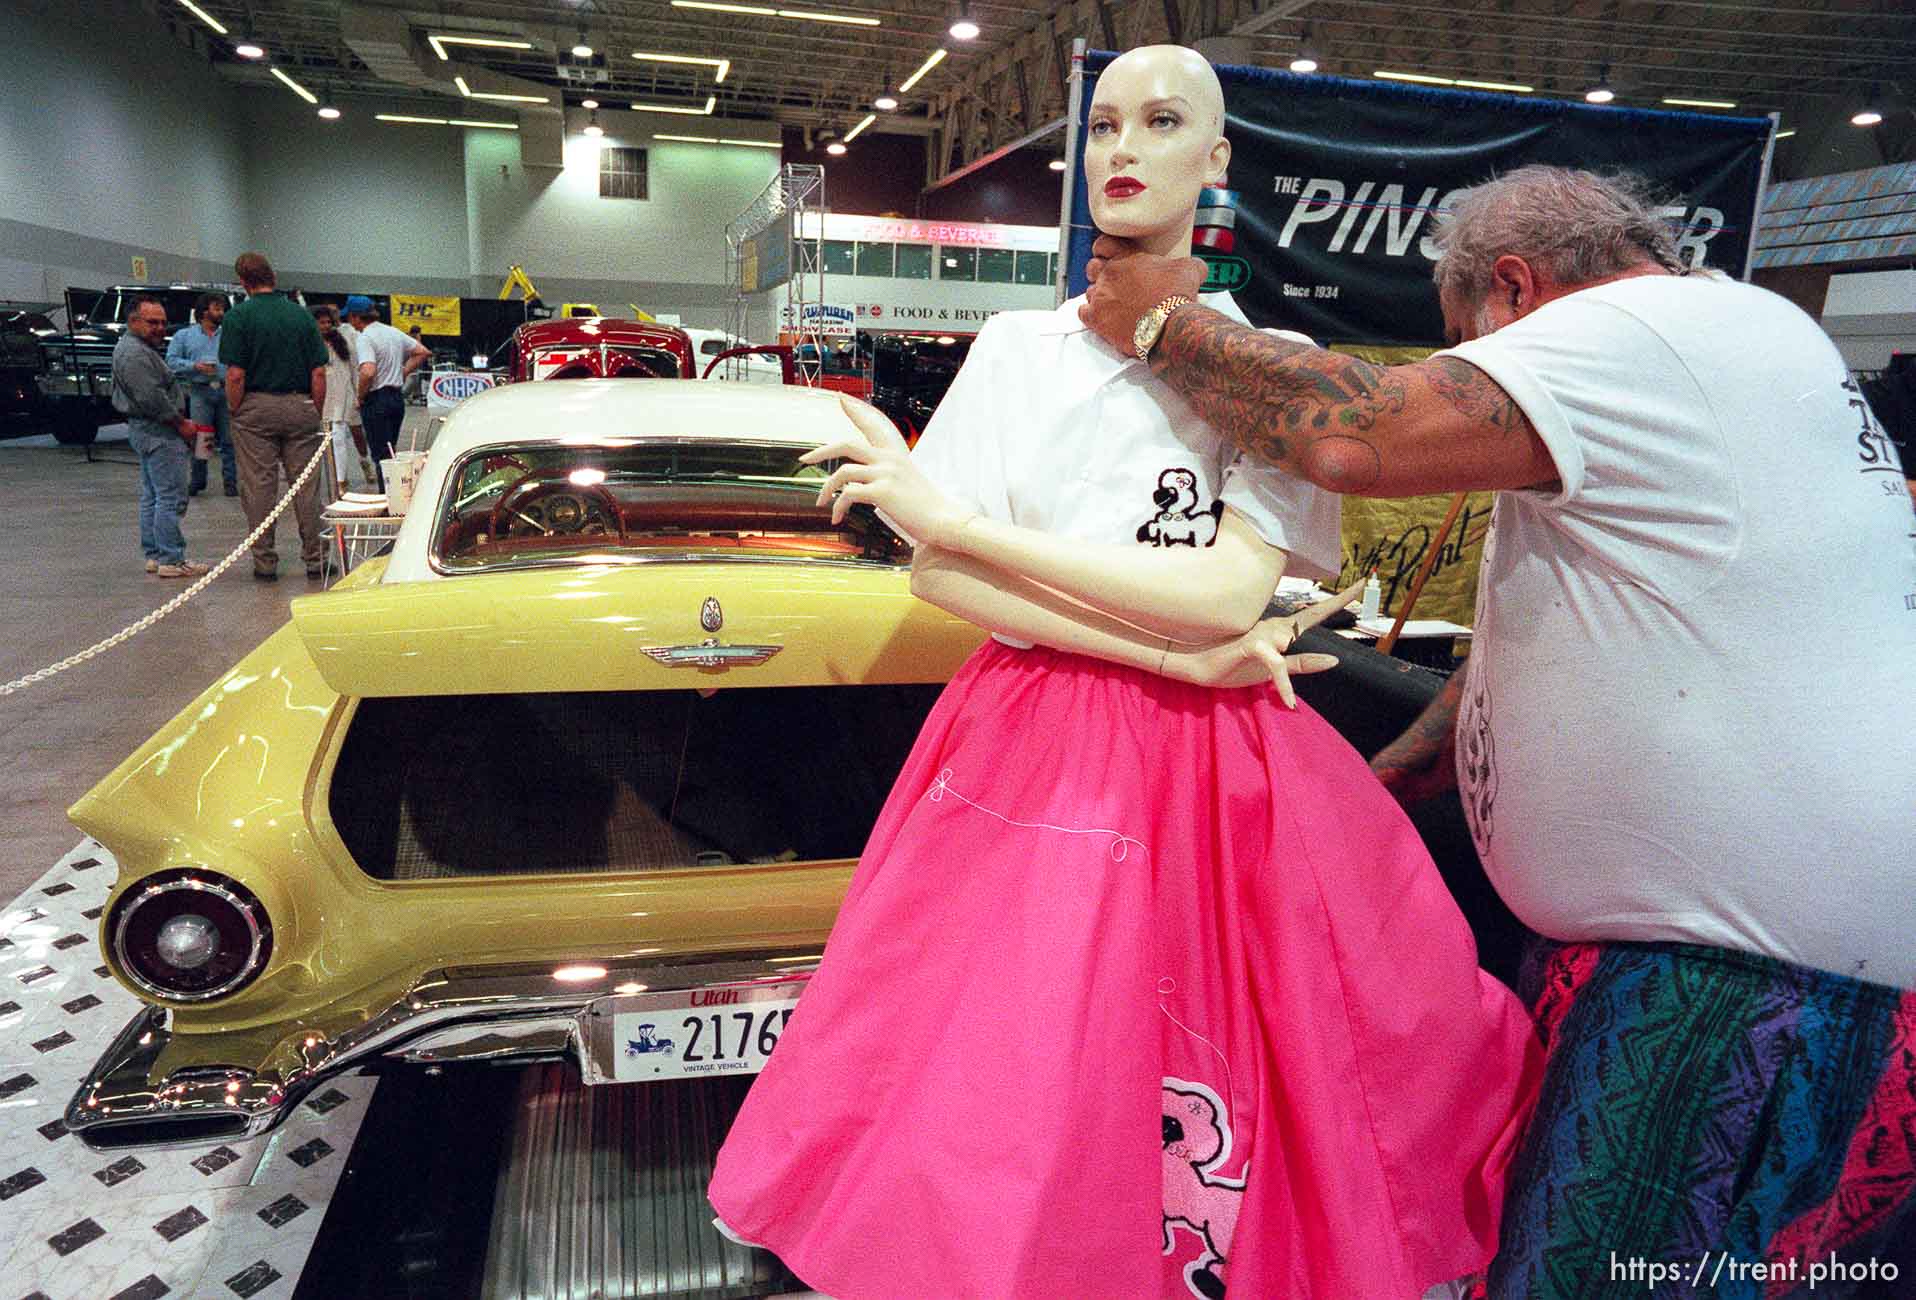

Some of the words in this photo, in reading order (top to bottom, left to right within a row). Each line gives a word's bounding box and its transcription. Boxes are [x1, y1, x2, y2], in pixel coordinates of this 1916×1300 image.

[1273, 176, 1302, 195] THE
[911, 223, 923, 239] &
[1283, 283, 1310, 297] Since
[1314, 285, 1339, 299] 1934
[893, 306, 934, 320] FOOD
[938, 308, 950, 321] &
[954, 310, 1000, 322] BEVE
[781, 325, 853, 335] SHOWCASE
[442, 377, 486, 398] NHRA
[690, 988, 739, 1008] Utah
[682, 1008, 795, 1063] 2176
[682, 1064, 716, 1074] VINTAGE
[717, 1061, 750, 1072] VEHICLE
